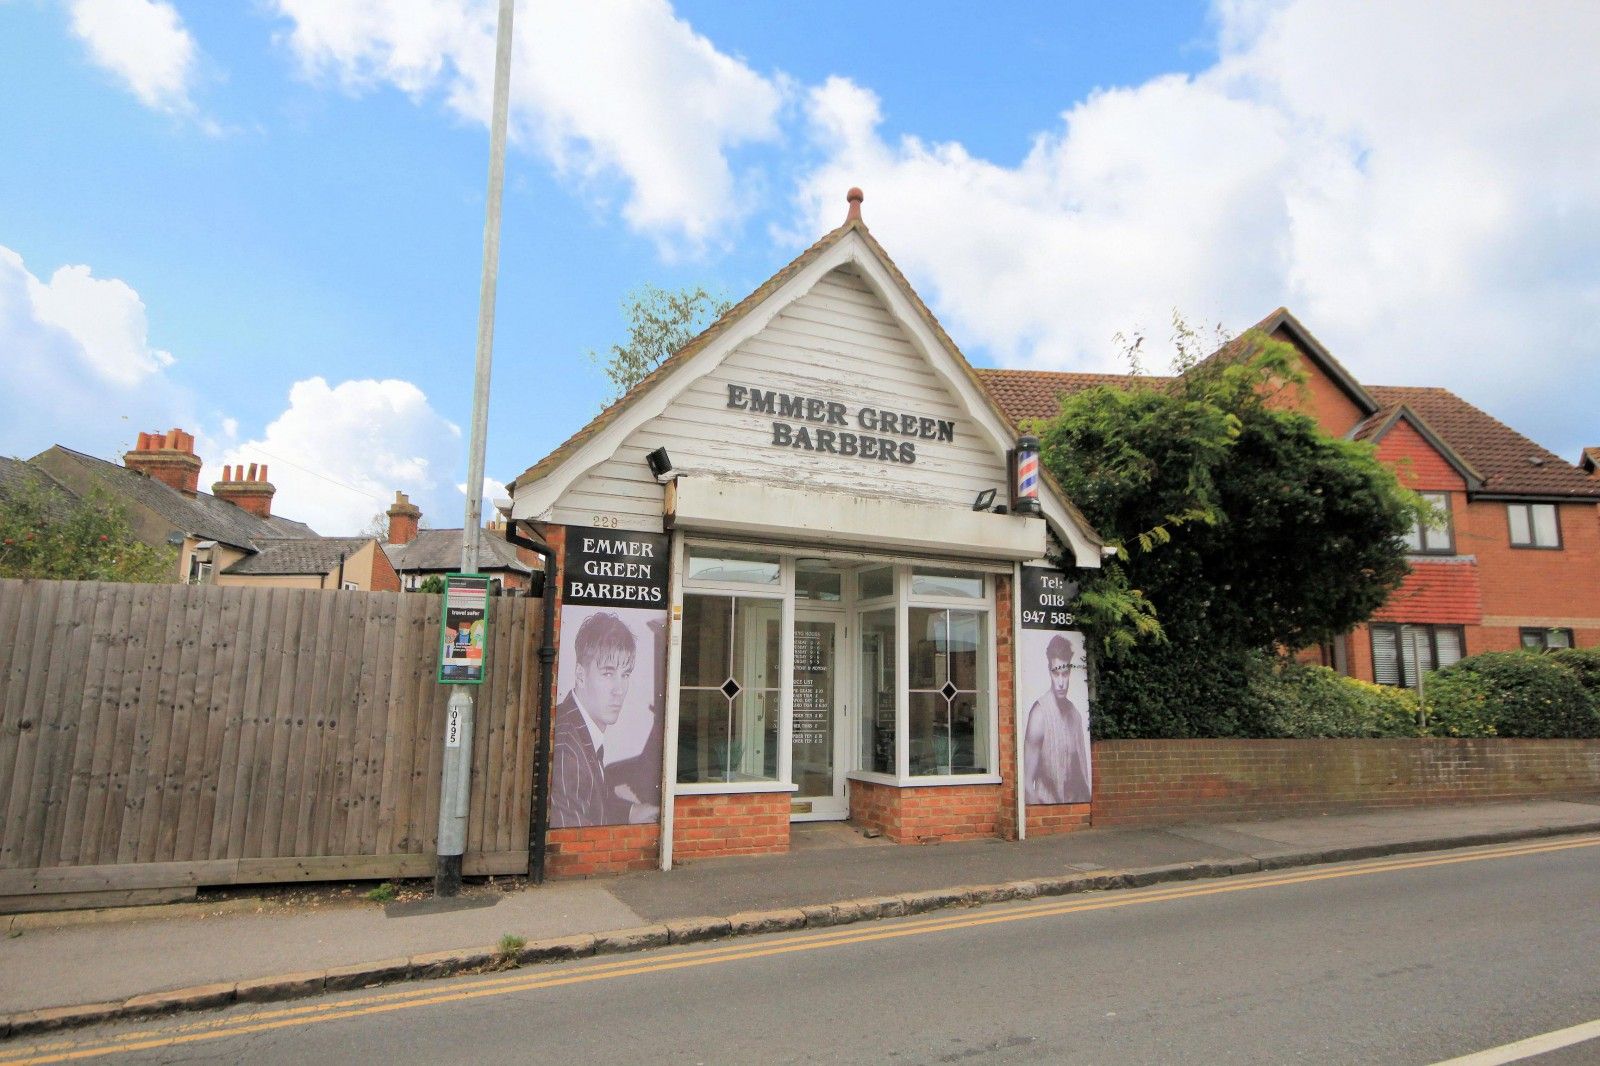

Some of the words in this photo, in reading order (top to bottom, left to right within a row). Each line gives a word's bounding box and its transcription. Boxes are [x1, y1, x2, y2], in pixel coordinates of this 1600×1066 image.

[727, 384, 849, 426] EMMER
[857, 407, 955, 443] GREEN
[772, 421, 916, 464] BARBERS
[593, 515, 618, 529] 229
[582, 537, 654, 558] EMMER
[583, 560, 652, 579] GREEN
[570, 581, 661, 602] BARBERS
[1040, 575, 1064, 589] Tel:
[1039, 593, 1065, 607] 0118
[1022, 610, 1046, 624] 947
[1050, 611, 1078, 626] 585
[450, 705, 458, 743] 10495
